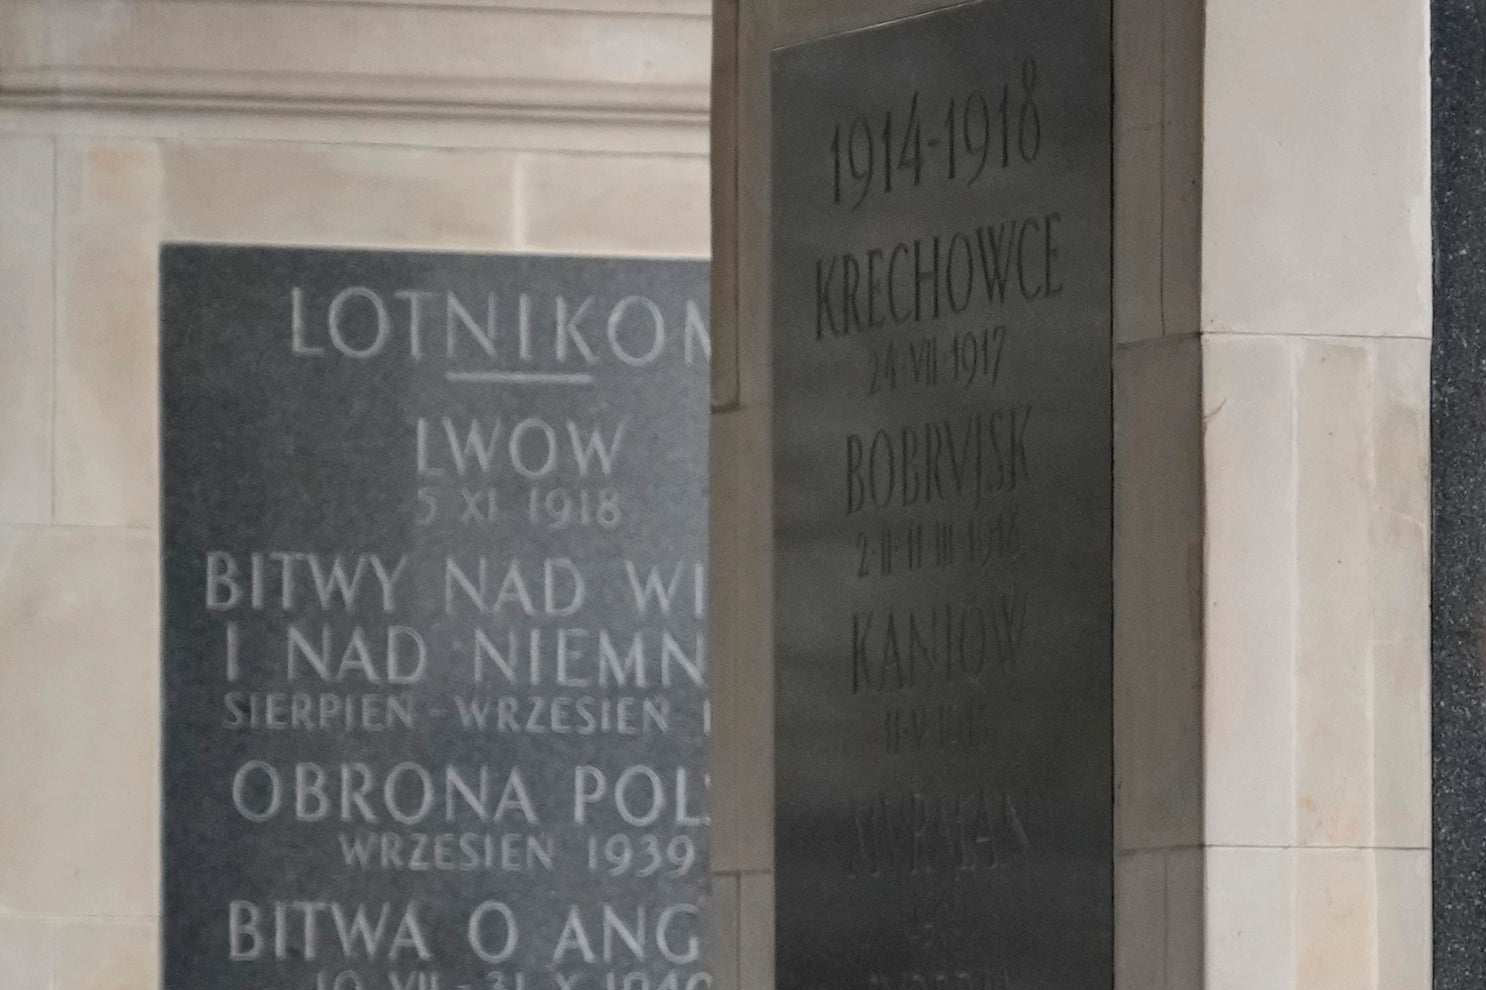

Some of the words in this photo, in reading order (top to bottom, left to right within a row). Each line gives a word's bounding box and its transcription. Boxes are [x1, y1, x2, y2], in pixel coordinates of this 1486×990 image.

[830, 55, 1041, 213] 1914-1918
[815, 211, 1064, 343] KRECHOWCE
[416, 487, 437, 528] 5
[459, 487, 497, 526] XI
[528, 487, 622, 530] 1918
[205, 551, 409, 613] BITWY
[446, 556, 585, 616] NAD
[227, 621, 239, 681] I
[287, 624, 428, 685] NAD
[473, 627, 708, 688] NIEMN
[231, 760, 538, 826] OBRONA
[573, 763, 711, 828] POL
[586, 833, 697, 879] 1939
[229, 899, 432, 962] BITWA
[467, 901, 519, 964] O
[553, 902, 701, 965] ANG
